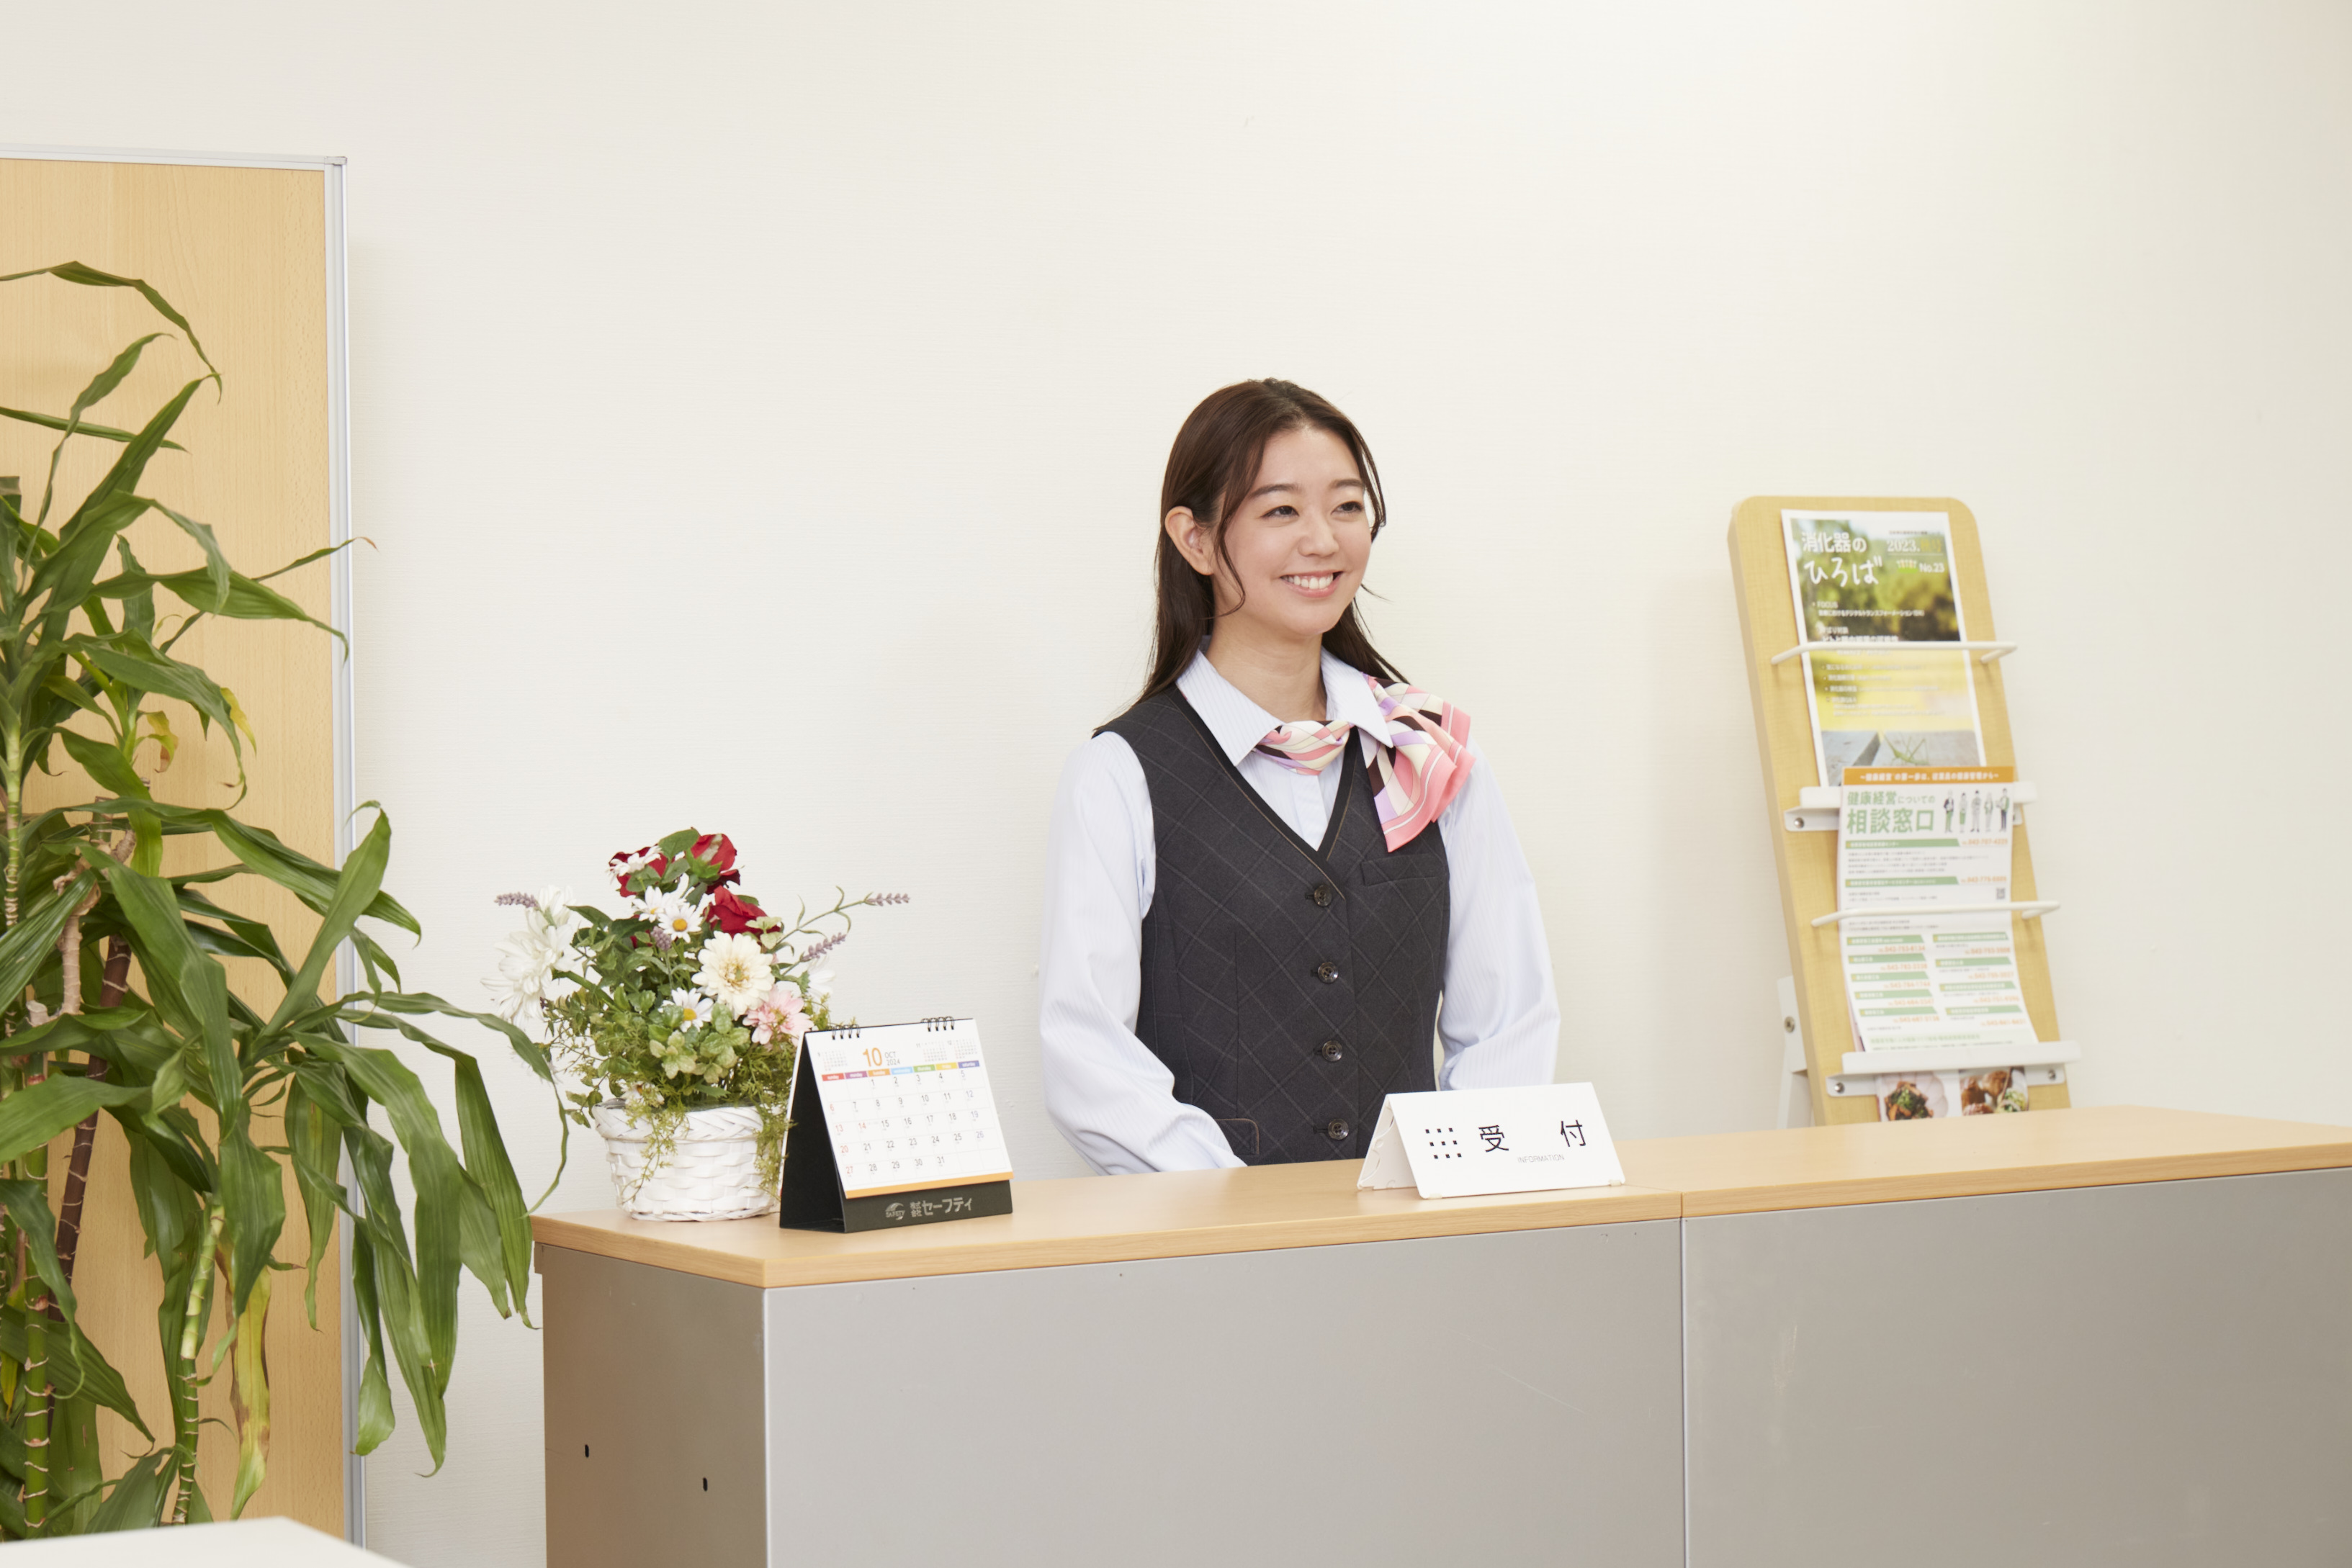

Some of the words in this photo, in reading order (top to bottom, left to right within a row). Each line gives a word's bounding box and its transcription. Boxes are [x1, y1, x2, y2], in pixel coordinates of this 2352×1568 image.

[1801, 532, 1867, 553] 消化器の
[1803, 555, 1883, 587] ひろば
[1918, 562, 1945, 573] No.23
[1847, 790, 1936, 806] 健康経営についての
[1846, 808, 1934, 834] 相談窓口
[863, 1047, 882, 1067] 10
[953, 1133, 962, 1142] 25
[1478, 1119, 1586, 1153] 受付
[1517, 1154, 1565, 1163] INFORMATION
[885, 1209, 905, 1218] SAFETY
[923, 1197, 972, 1216] セーフティ
